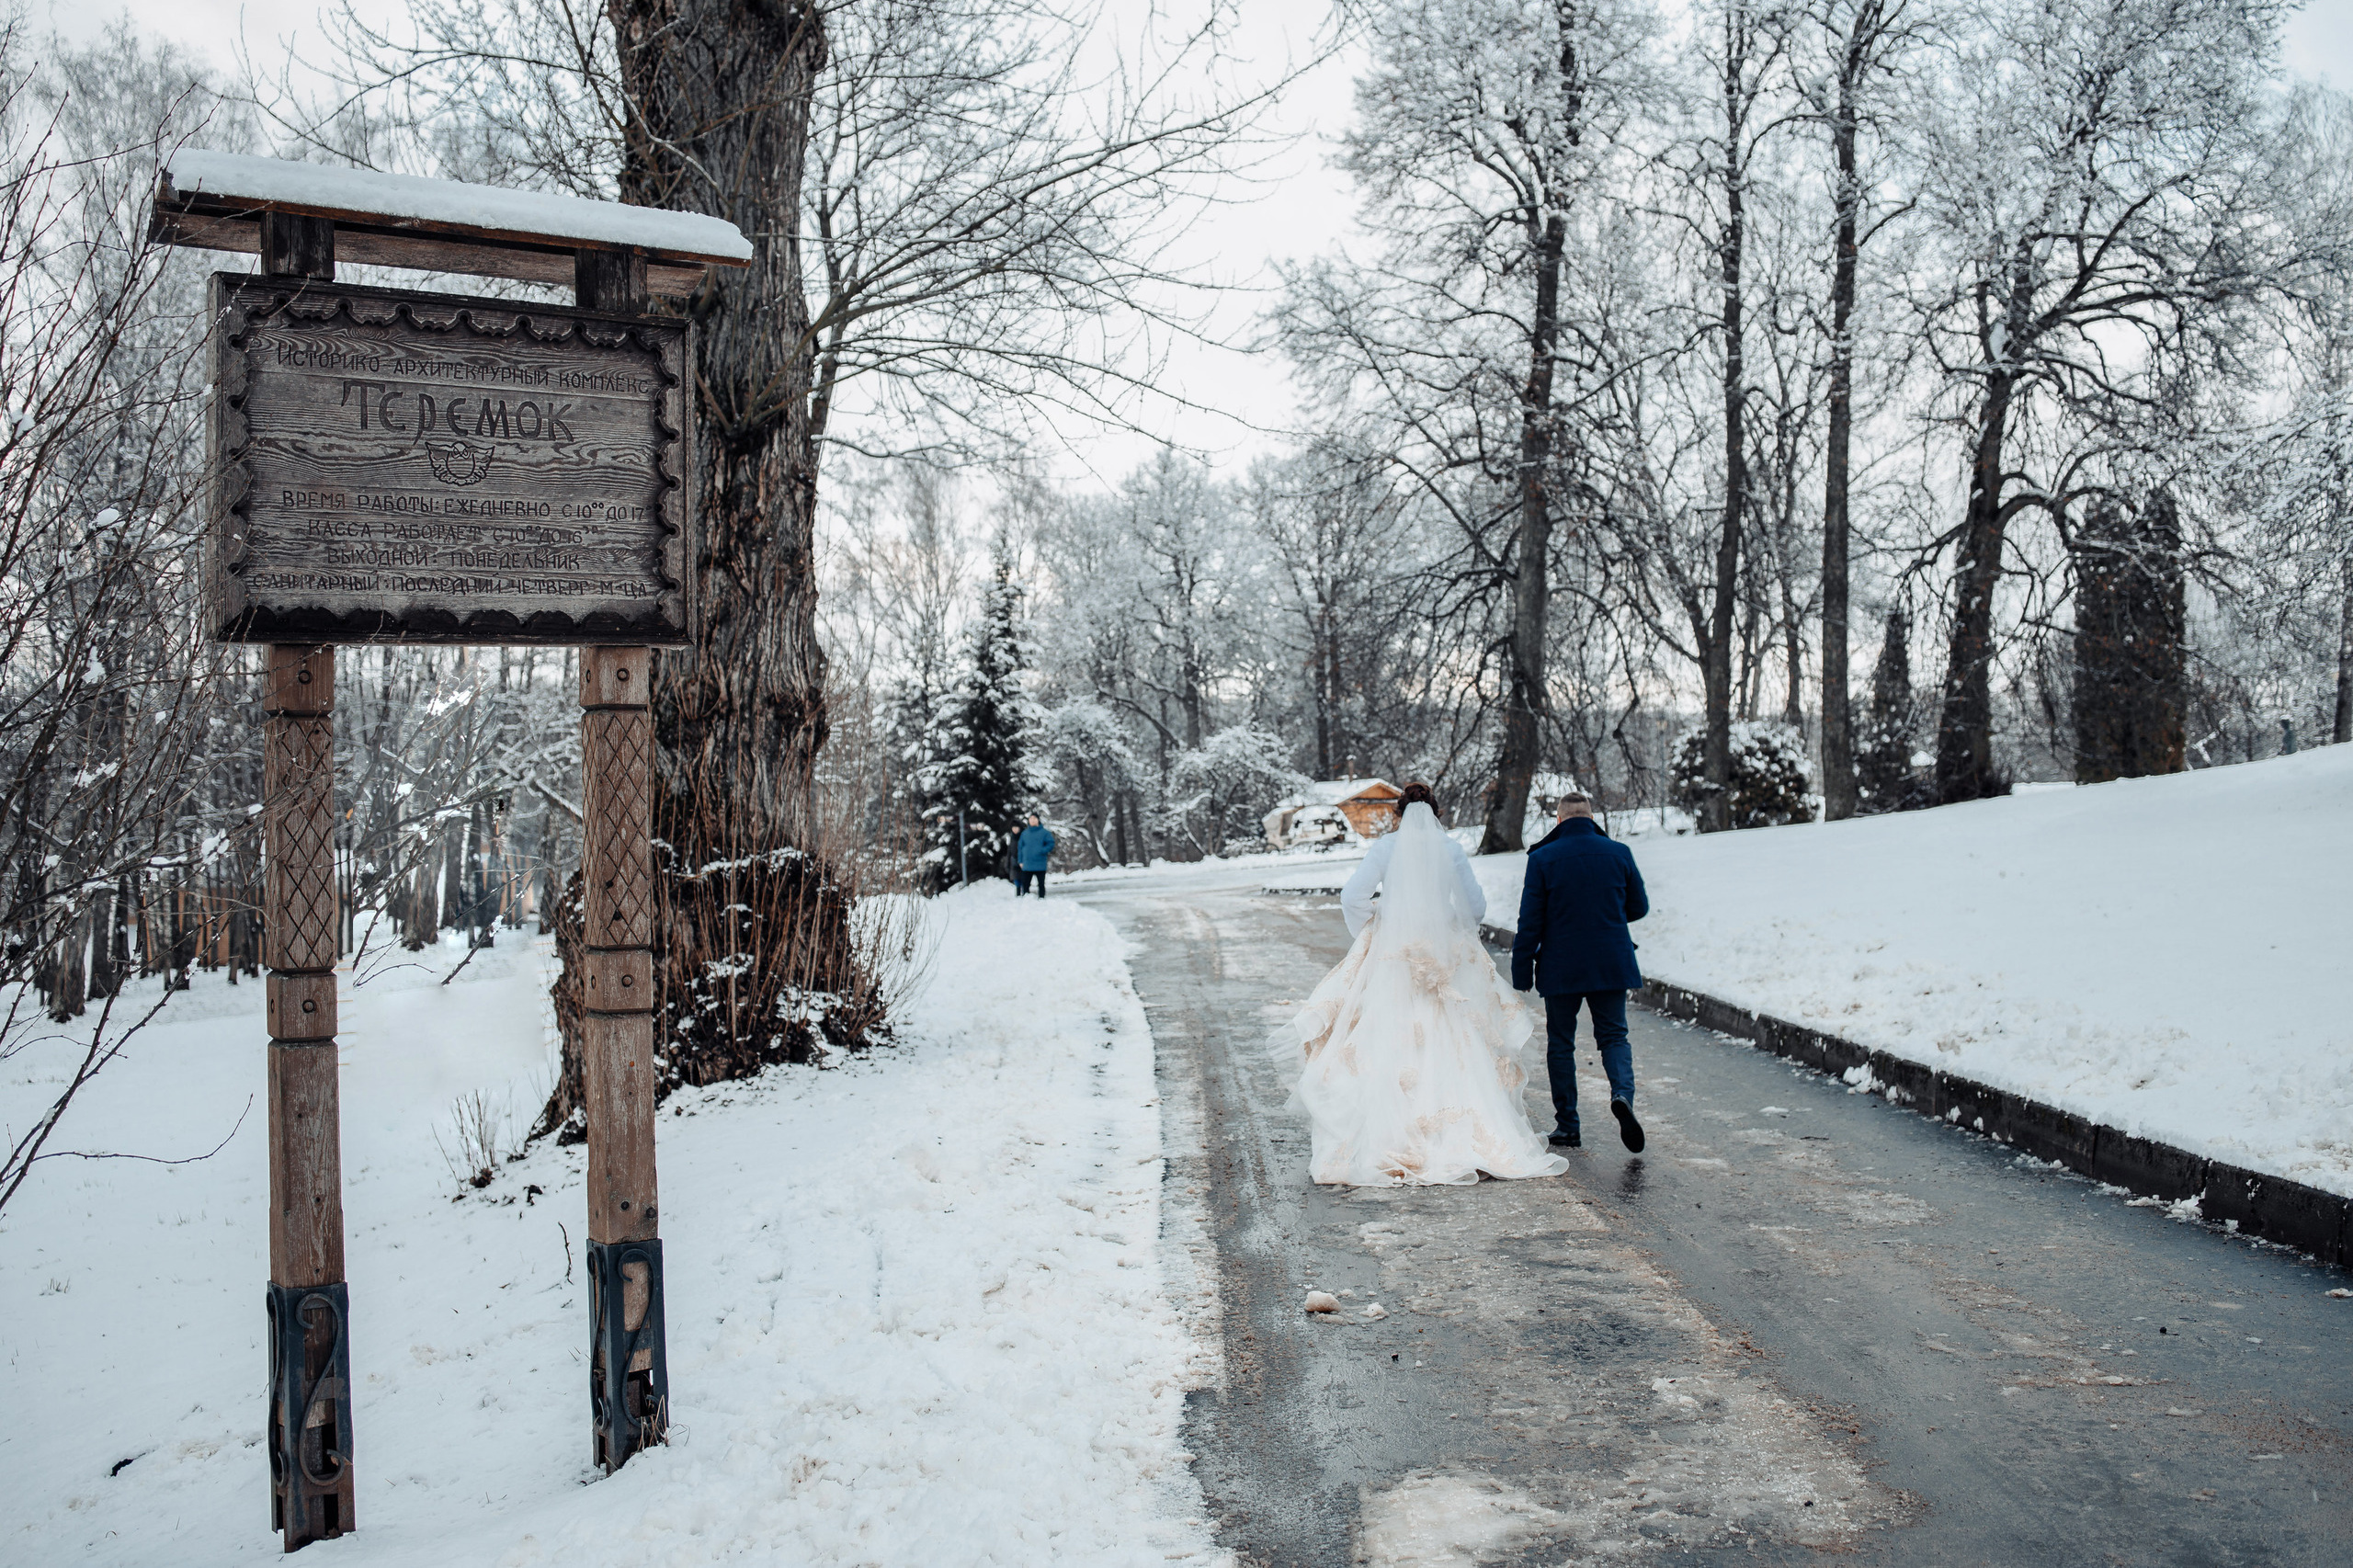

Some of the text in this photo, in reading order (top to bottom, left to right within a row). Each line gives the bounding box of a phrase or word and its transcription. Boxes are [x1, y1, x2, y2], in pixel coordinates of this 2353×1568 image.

[559, 372, 649, 394] КОМПЛЕКС
[341, 380, 574, 446] ТЕРЕМОК
[282, 490, 346, 509] ВРЕМЯ
[358, 494, 439, 513] РАБОТЫ:
[445, 497, 551, 517] ЕЖЕДНЕВНО
[309, 518, 371, 538] КАССА
[383, 522, 482, 541] РАБОТАЕТ
[451, 551, 580, 570] ПОНЕДЕЛЬНИК
[392, 573, 501, 595] ПОСЛЕДНИЙ
[511, 579, 588, 596] ЧЕТВЕРГ
